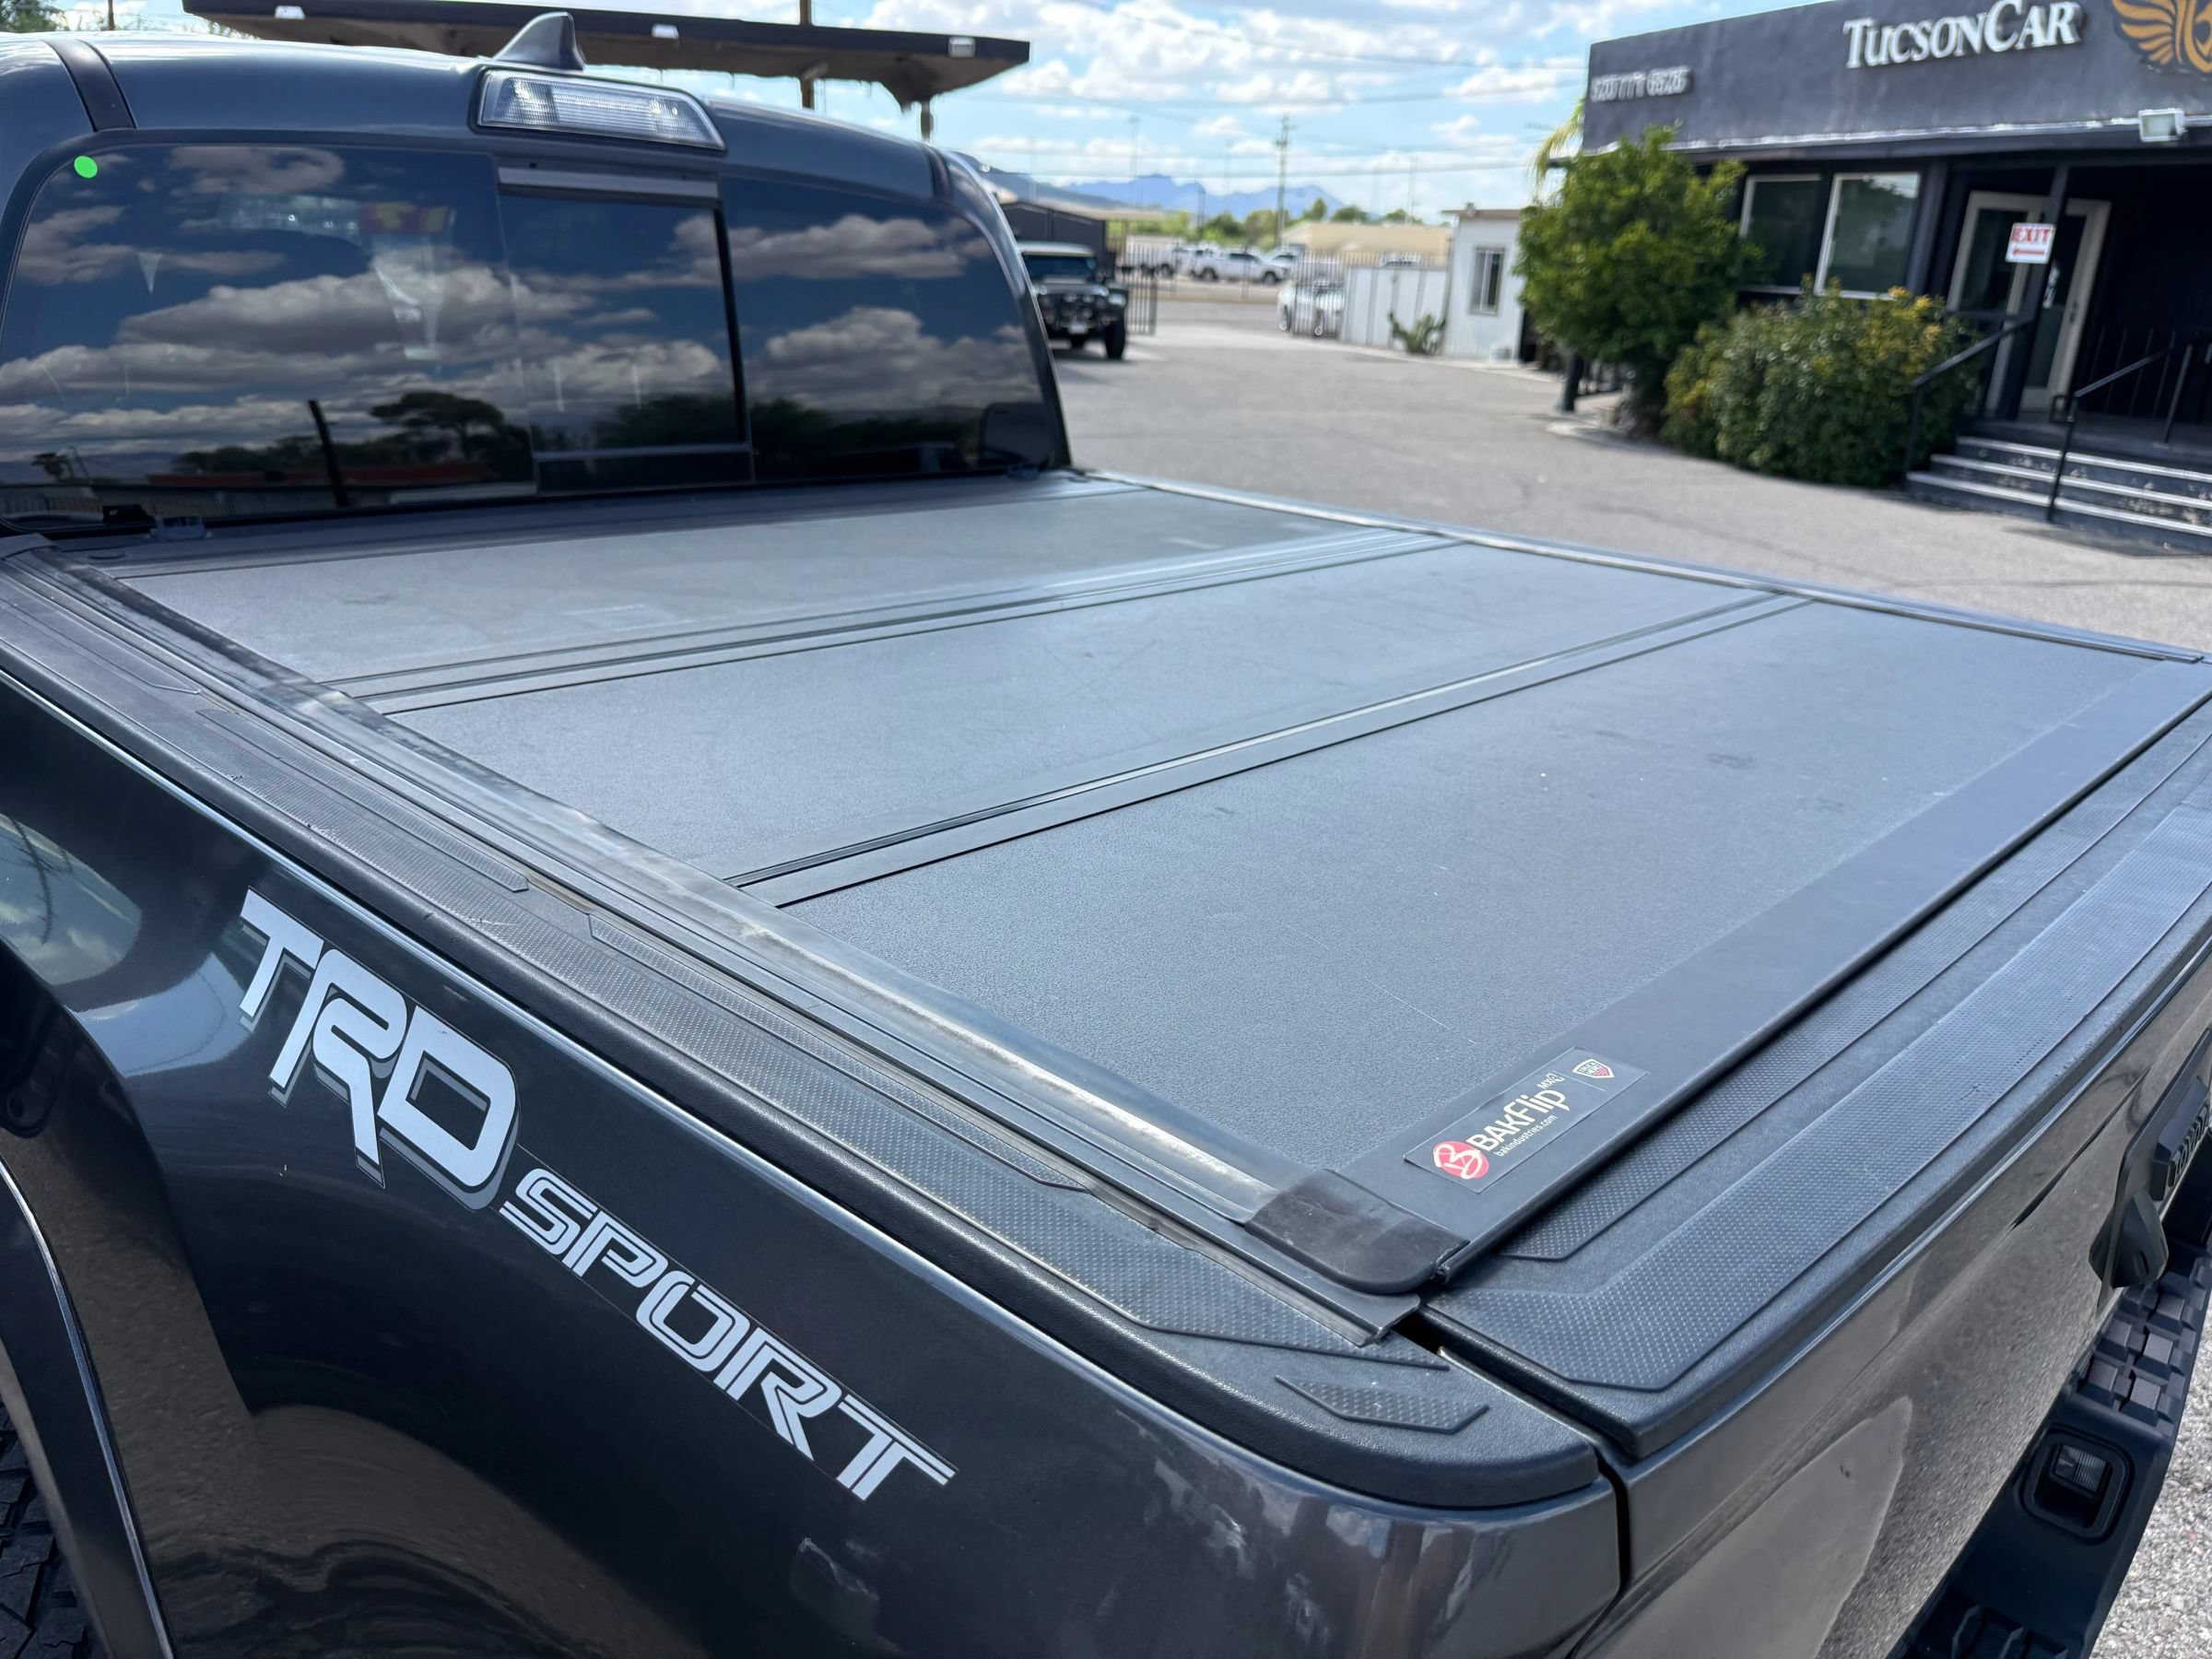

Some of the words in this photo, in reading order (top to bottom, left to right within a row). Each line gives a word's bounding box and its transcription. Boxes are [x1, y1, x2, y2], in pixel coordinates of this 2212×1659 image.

[2011, 225, 2052, 242] EXIT
[1493, 1114, 1559, 1157] bakindustries.com
[239, 887, 518, 1208] TRD
[500, 1168, 957, 1500] SPORT
